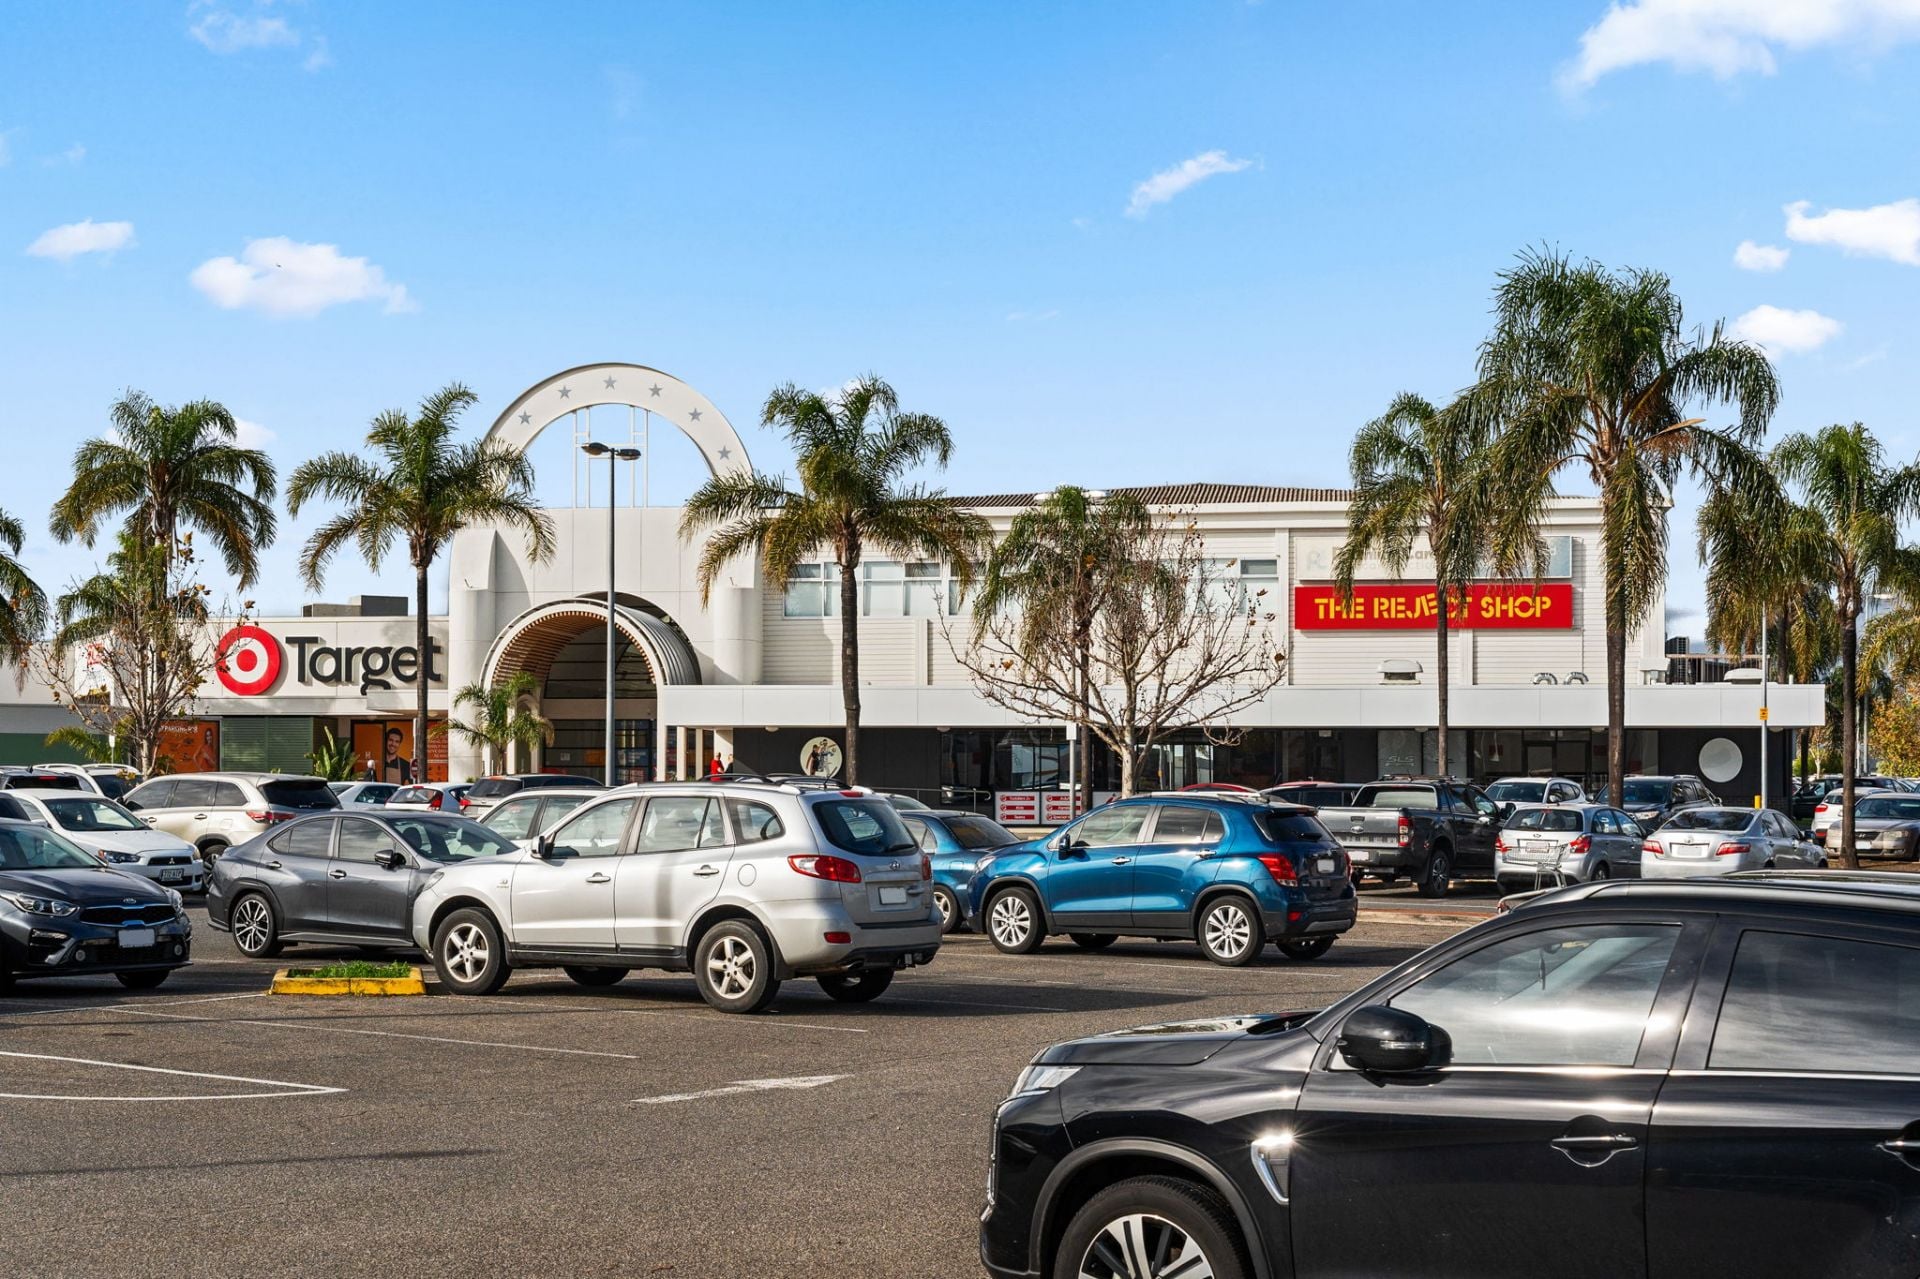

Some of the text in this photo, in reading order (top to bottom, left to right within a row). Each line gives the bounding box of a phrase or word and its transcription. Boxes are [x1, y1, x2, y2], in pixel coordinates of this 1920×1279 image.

[1314, 597, 1365, 620] THE
[1480, 595, 1552, 619] SHOP
[285, 636, 442, 696] Target
